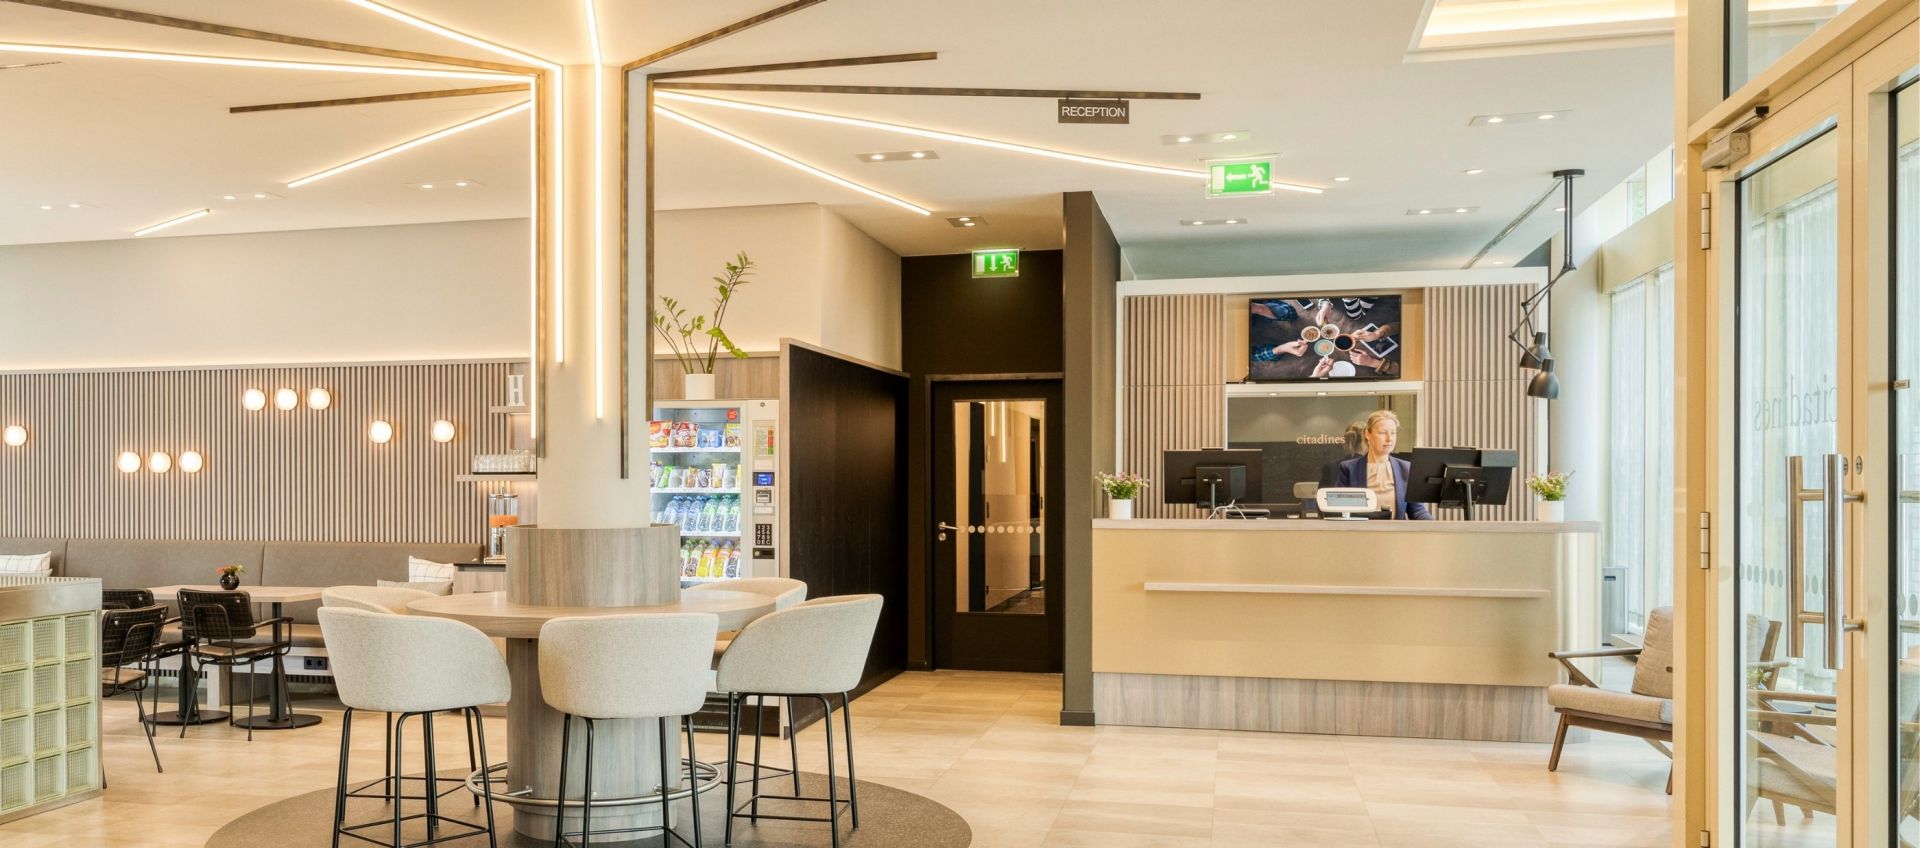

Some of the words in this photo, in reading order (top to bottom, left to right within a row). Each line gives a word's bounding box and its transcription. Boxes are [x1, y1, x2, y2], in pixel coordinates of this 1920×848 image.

[1061, 106, 1126, 118] RECEPTION
[508, 374, 525, 407] H
[1296, 434, 1346, 445] citadines
